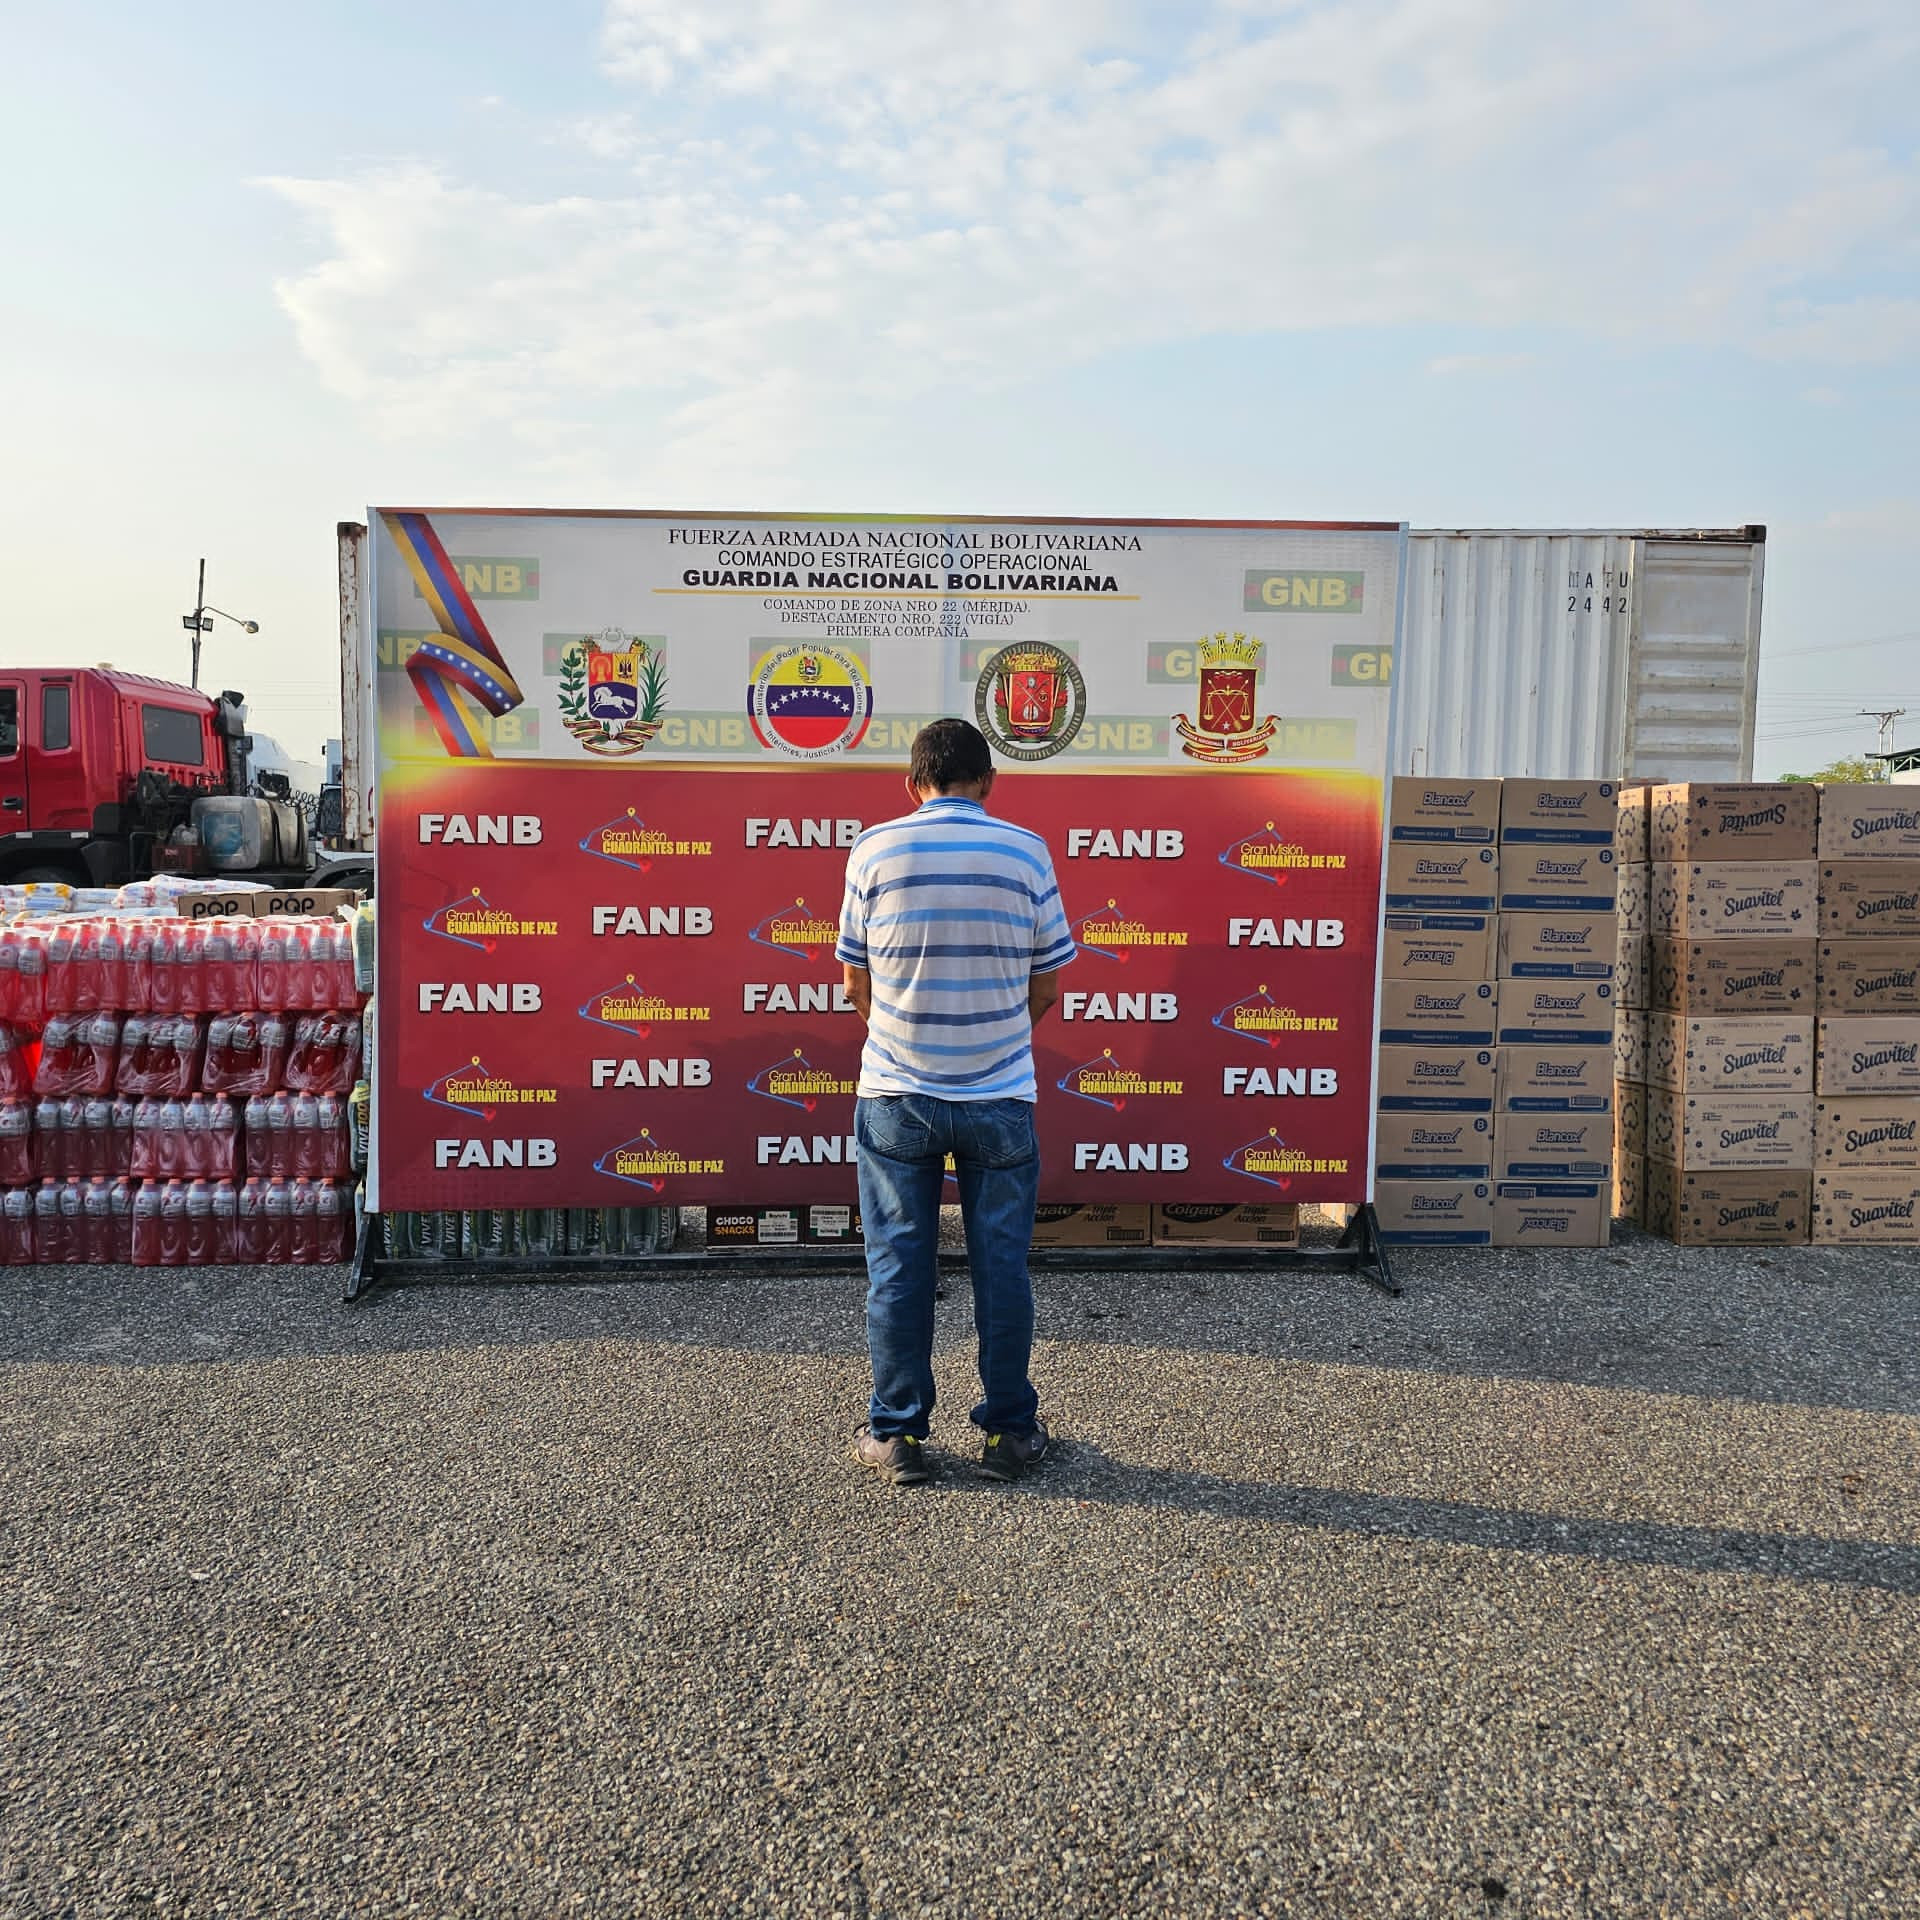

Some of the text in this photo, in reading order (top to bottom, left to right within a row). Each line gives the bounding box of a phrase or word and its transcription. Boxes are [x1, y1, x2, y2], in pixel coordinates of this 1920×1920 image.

[668, 529, 1143, 551] FUERZA ARMADA NACIONAL BOLIVARIANA
[718, 549, 1093, 571] COMANDO ESTRATÉGICO OPERACIONAL
[454, 564, 521, 593] NB
[683, 569, 1119, 592] GUARDIA NACIONAL BOLIVARIANA
[1262, 578, 1347, 606] GNB
[763, 599, 836, 610] COMANDO
[841, 600, 860, 611] DE
[864, 600, 902, 611] ZONA
[906, 601, 938, 612] NRO
[942, 601, 957, 612] 22
[1567, 596, 1627, 613] 2442
[781, 612, 1014, 626] DESTACAMENTO NRO. 222 (VIGÍA)
[827, 625, 890, 637] PRIMERA
[756, 643, 863, 716] Ministerio del Poder Popular para Relaciones
[660, 719, 745, 747] GNB
[766, 730, 802, 759] Interiores,
[805, 747, 835, 759] Justicia
[840, 730, 855, 746] Paz
[1423, 790, 1474, 807] Blancox
[1537, 792, 1587, 809] Blancox
[420, 815, 542, 844] FANB
[602, 830, 666, 842] Gran Misión
[745, 818, 862, 848] FANB
[603, 840, 712, 854] CUADRANTES DE PAZ
[1068, 829, 1184, 858] FANB
[1240, 844, 1302, 856] Gran Misión
[1241, 854, 1345, 868] CUADRANTES DE PAZ
[1416, 858, 1468, 874] Blancox
[1537, 858, 1587, 875] Blancox
[446, 910, 511, 922] Gran Misión
[593, 907, 712, 935] FANB
[447, 920, 557, 934] CUADRANTES DE PAZ
[770, 919, 834, 931] Gran Misión
[1082, 920, 1144, 932] Gran Misión
[1229, 919, 1344, 947] FANB
[771, 931, 840, 944] CUADRANTES
[1083, 930, 1187, 944] CUADRANTES DE PAZ
[1540, 926, 1592, 943] Blancox
[420, 984, 542, 1012] FANB
[601, 996, 665, 1008] Gran Misión
[1415, 993, 1466, 1009] Blancox
[1535, 993, 1585, 1009] Blancox
[602, 1006, 710, 1020] CUADRANTES DE PAZ
[1064, 993, 1178, 1020] FANB
[1234, 1006, 1295, 1018] Gran Misión
[1235, 1016, 1338, 1030] CUADRANTES DE PAZ
[593, 1059, 711, 1087] FANB
[768, 1070, 832, 1081] Gran Misión
[1079, 1070, 1140, 1082] Gran Misión
[1415, 1060, 1465, 1077] Blancox
[1536, 1061, 1587, 1077] Blancox
[447, 1078, 511, 1090] Gran Misión
[769, 1081, 854, 1094] CUADRANTES DE
[1080, 1080, 1182, 1094] CUADRANTES DE PAZ
[1224, 1068, 1338, 1095] FANB
[448, 1088, 556, 1102] CUADRANTES DE PAZ
[1411, 1127, 1462, 1144] Blancox
[1536, 1127, 1587, 1143] Blancox
[436, 1139, 556, 1168] FANB
[616, 1148, 679, 1160] Gran Misión
[1075, 1144, 1189, 1171] FANB
[1244, 1148, 1304, 1160] Gran Misión
[617, 1160, 724, 1174] CUADRANTES DE PAZ
[1245, 1158, 1346, 1172] CUADRANTES DE PAZ
[1412, 1193, 1463, 1210] Blancox
[1166, 1203, 1224, 1217] Colgate
[716, 1216, 754, 1226] CHOCO
[714, 1226, 755, 1236] SNACKS
